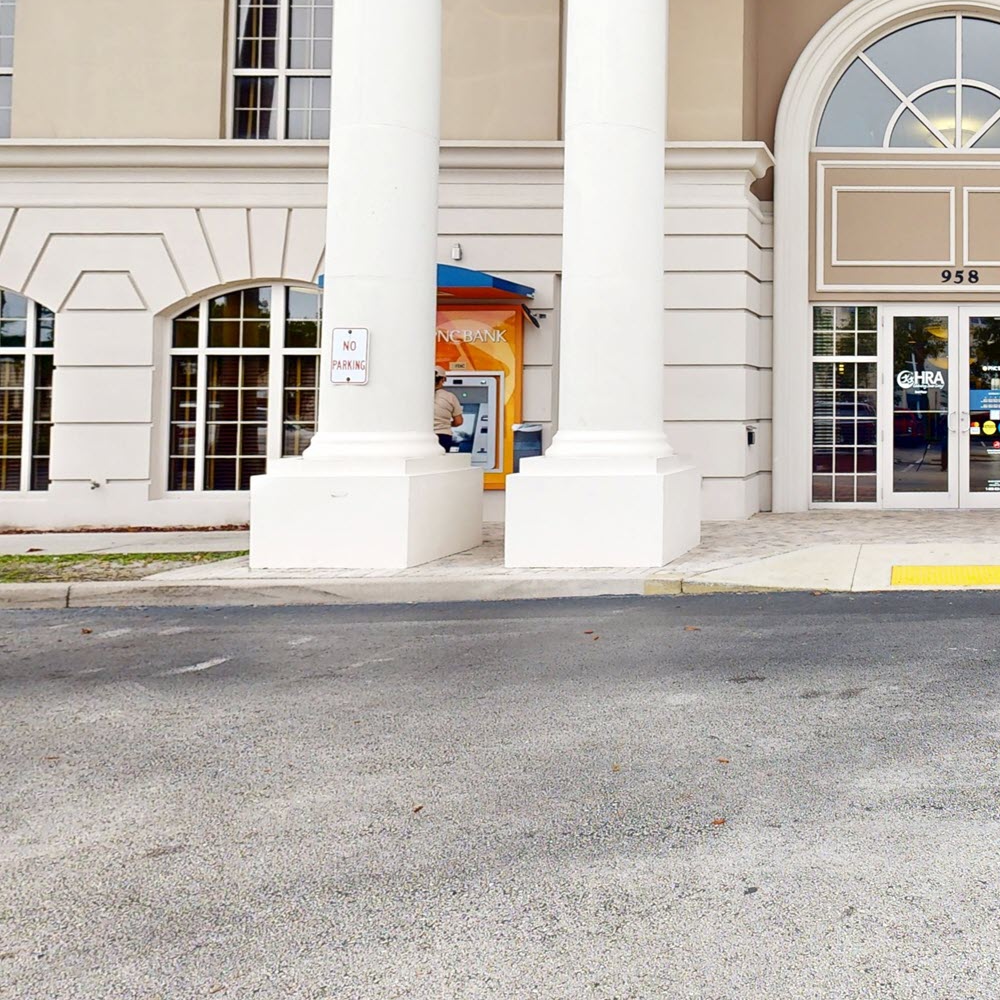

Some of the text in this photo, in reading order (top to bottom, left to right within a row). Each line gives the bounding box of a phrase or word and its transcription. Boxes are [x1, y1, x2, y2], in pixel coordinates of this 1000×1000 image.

[941, 269, 979, 284] 958
[463, 329, 507, 343] BANK
[343, 340, 357, 351] NO
[332, 360, 366, 371] PARKING
